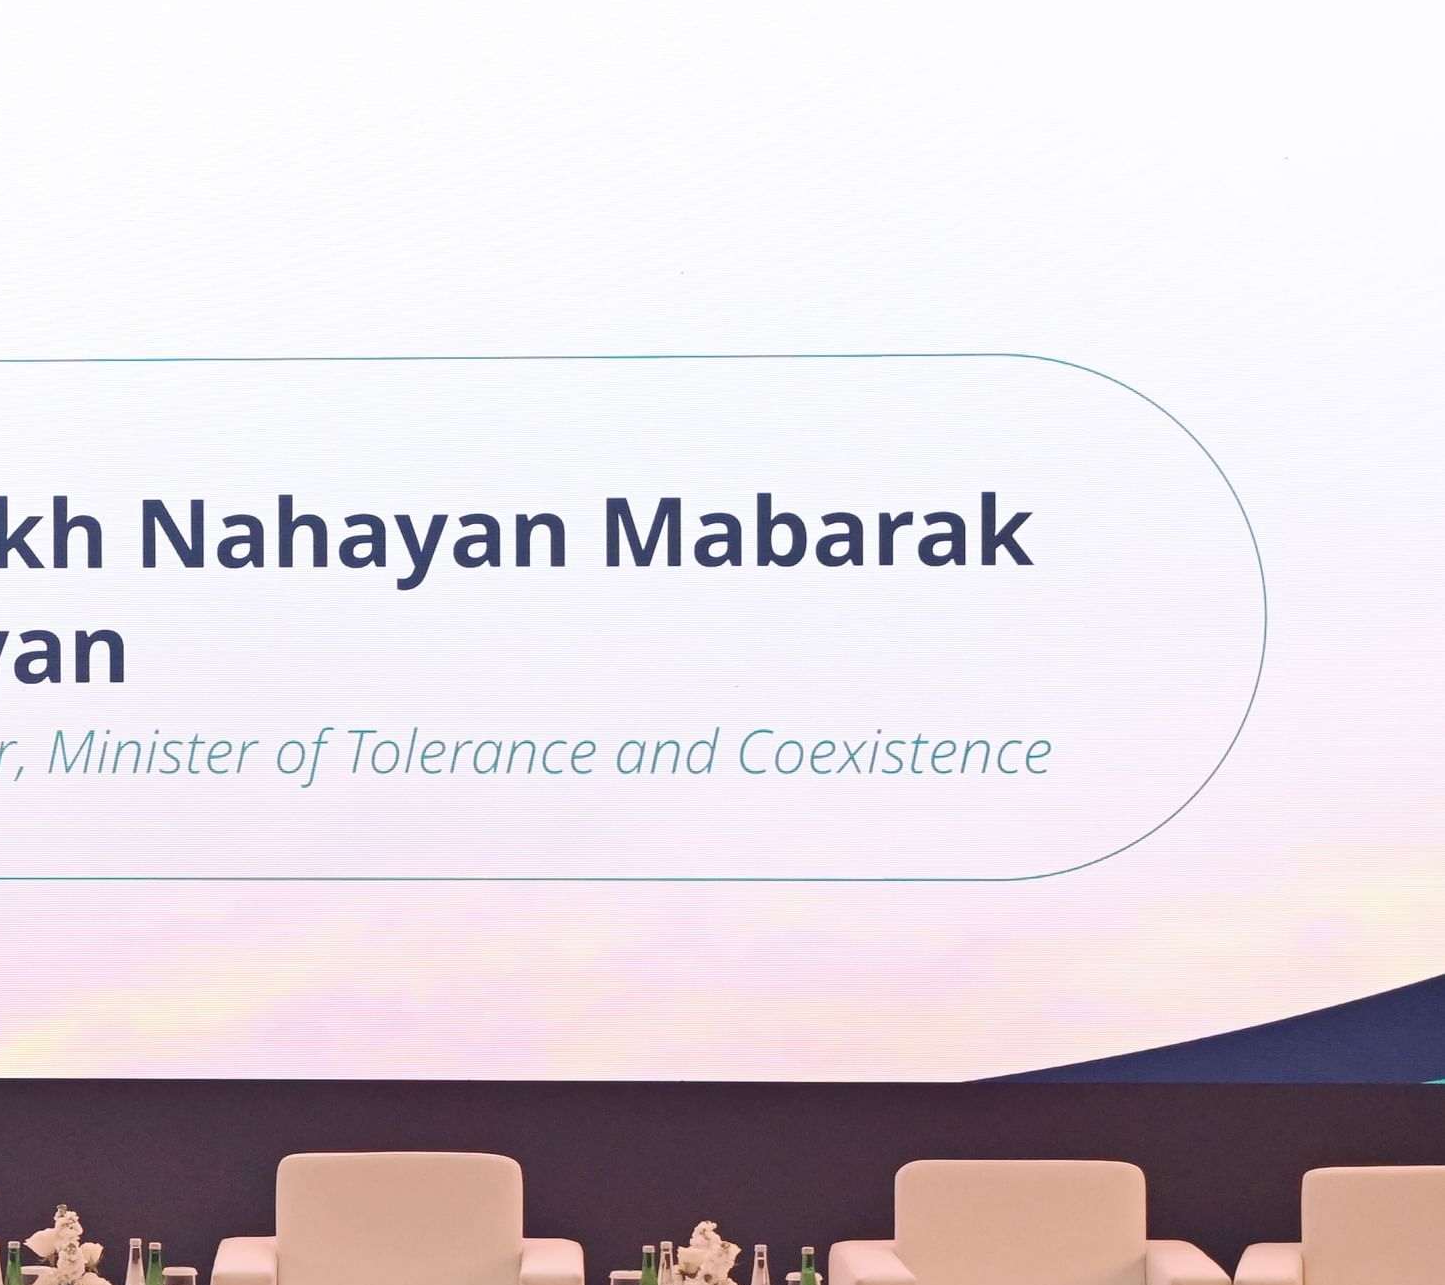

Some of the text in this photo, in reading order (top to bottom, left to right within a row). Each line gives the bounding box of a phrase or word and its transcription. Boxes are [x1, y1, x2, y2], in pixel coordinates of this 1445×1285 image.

[141, 493, 566, 592] Nahayan
[605, 491, 1035, 568] Mabarak
[47, 728, 261, 775] Minister
[276, 726, 336, 789] of
[346, 726, 597, 775] Tolerance
[615, 726, 721, 776] and
[738, 728, 1052, 776] Coexistence
